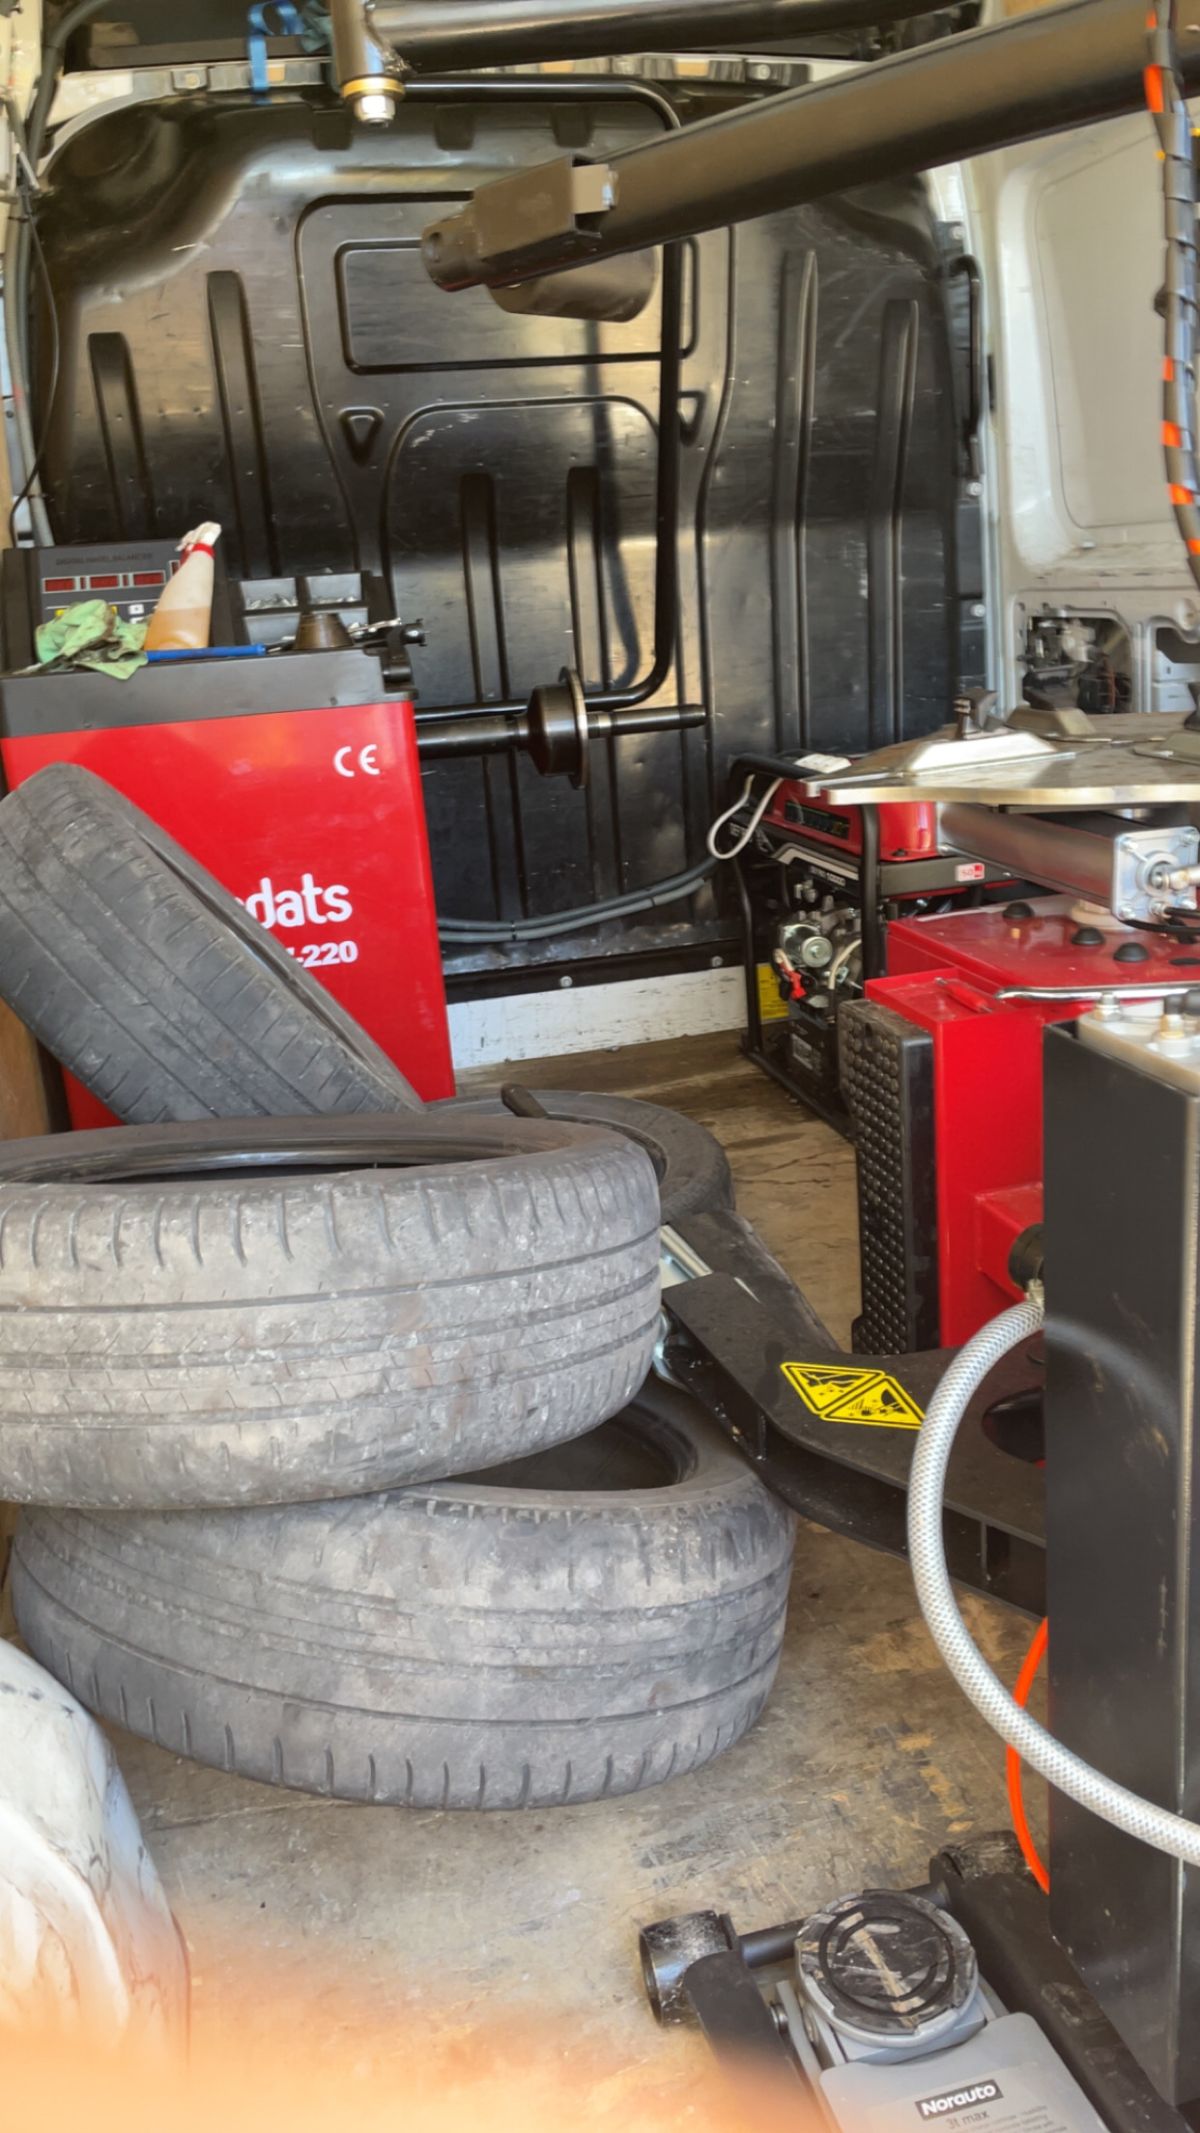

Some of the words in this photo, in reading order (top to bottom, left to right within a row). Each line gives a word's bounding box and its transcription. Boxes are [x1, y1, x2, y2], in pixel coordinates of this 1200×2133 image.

[334, 744, 380, 777] CE
[236, 873, 352, 929] dats
[286, 940, 358, 968] -220
[921, 2084, 996, 2116] Norauto
[962, 2110, 990, 2124] max
